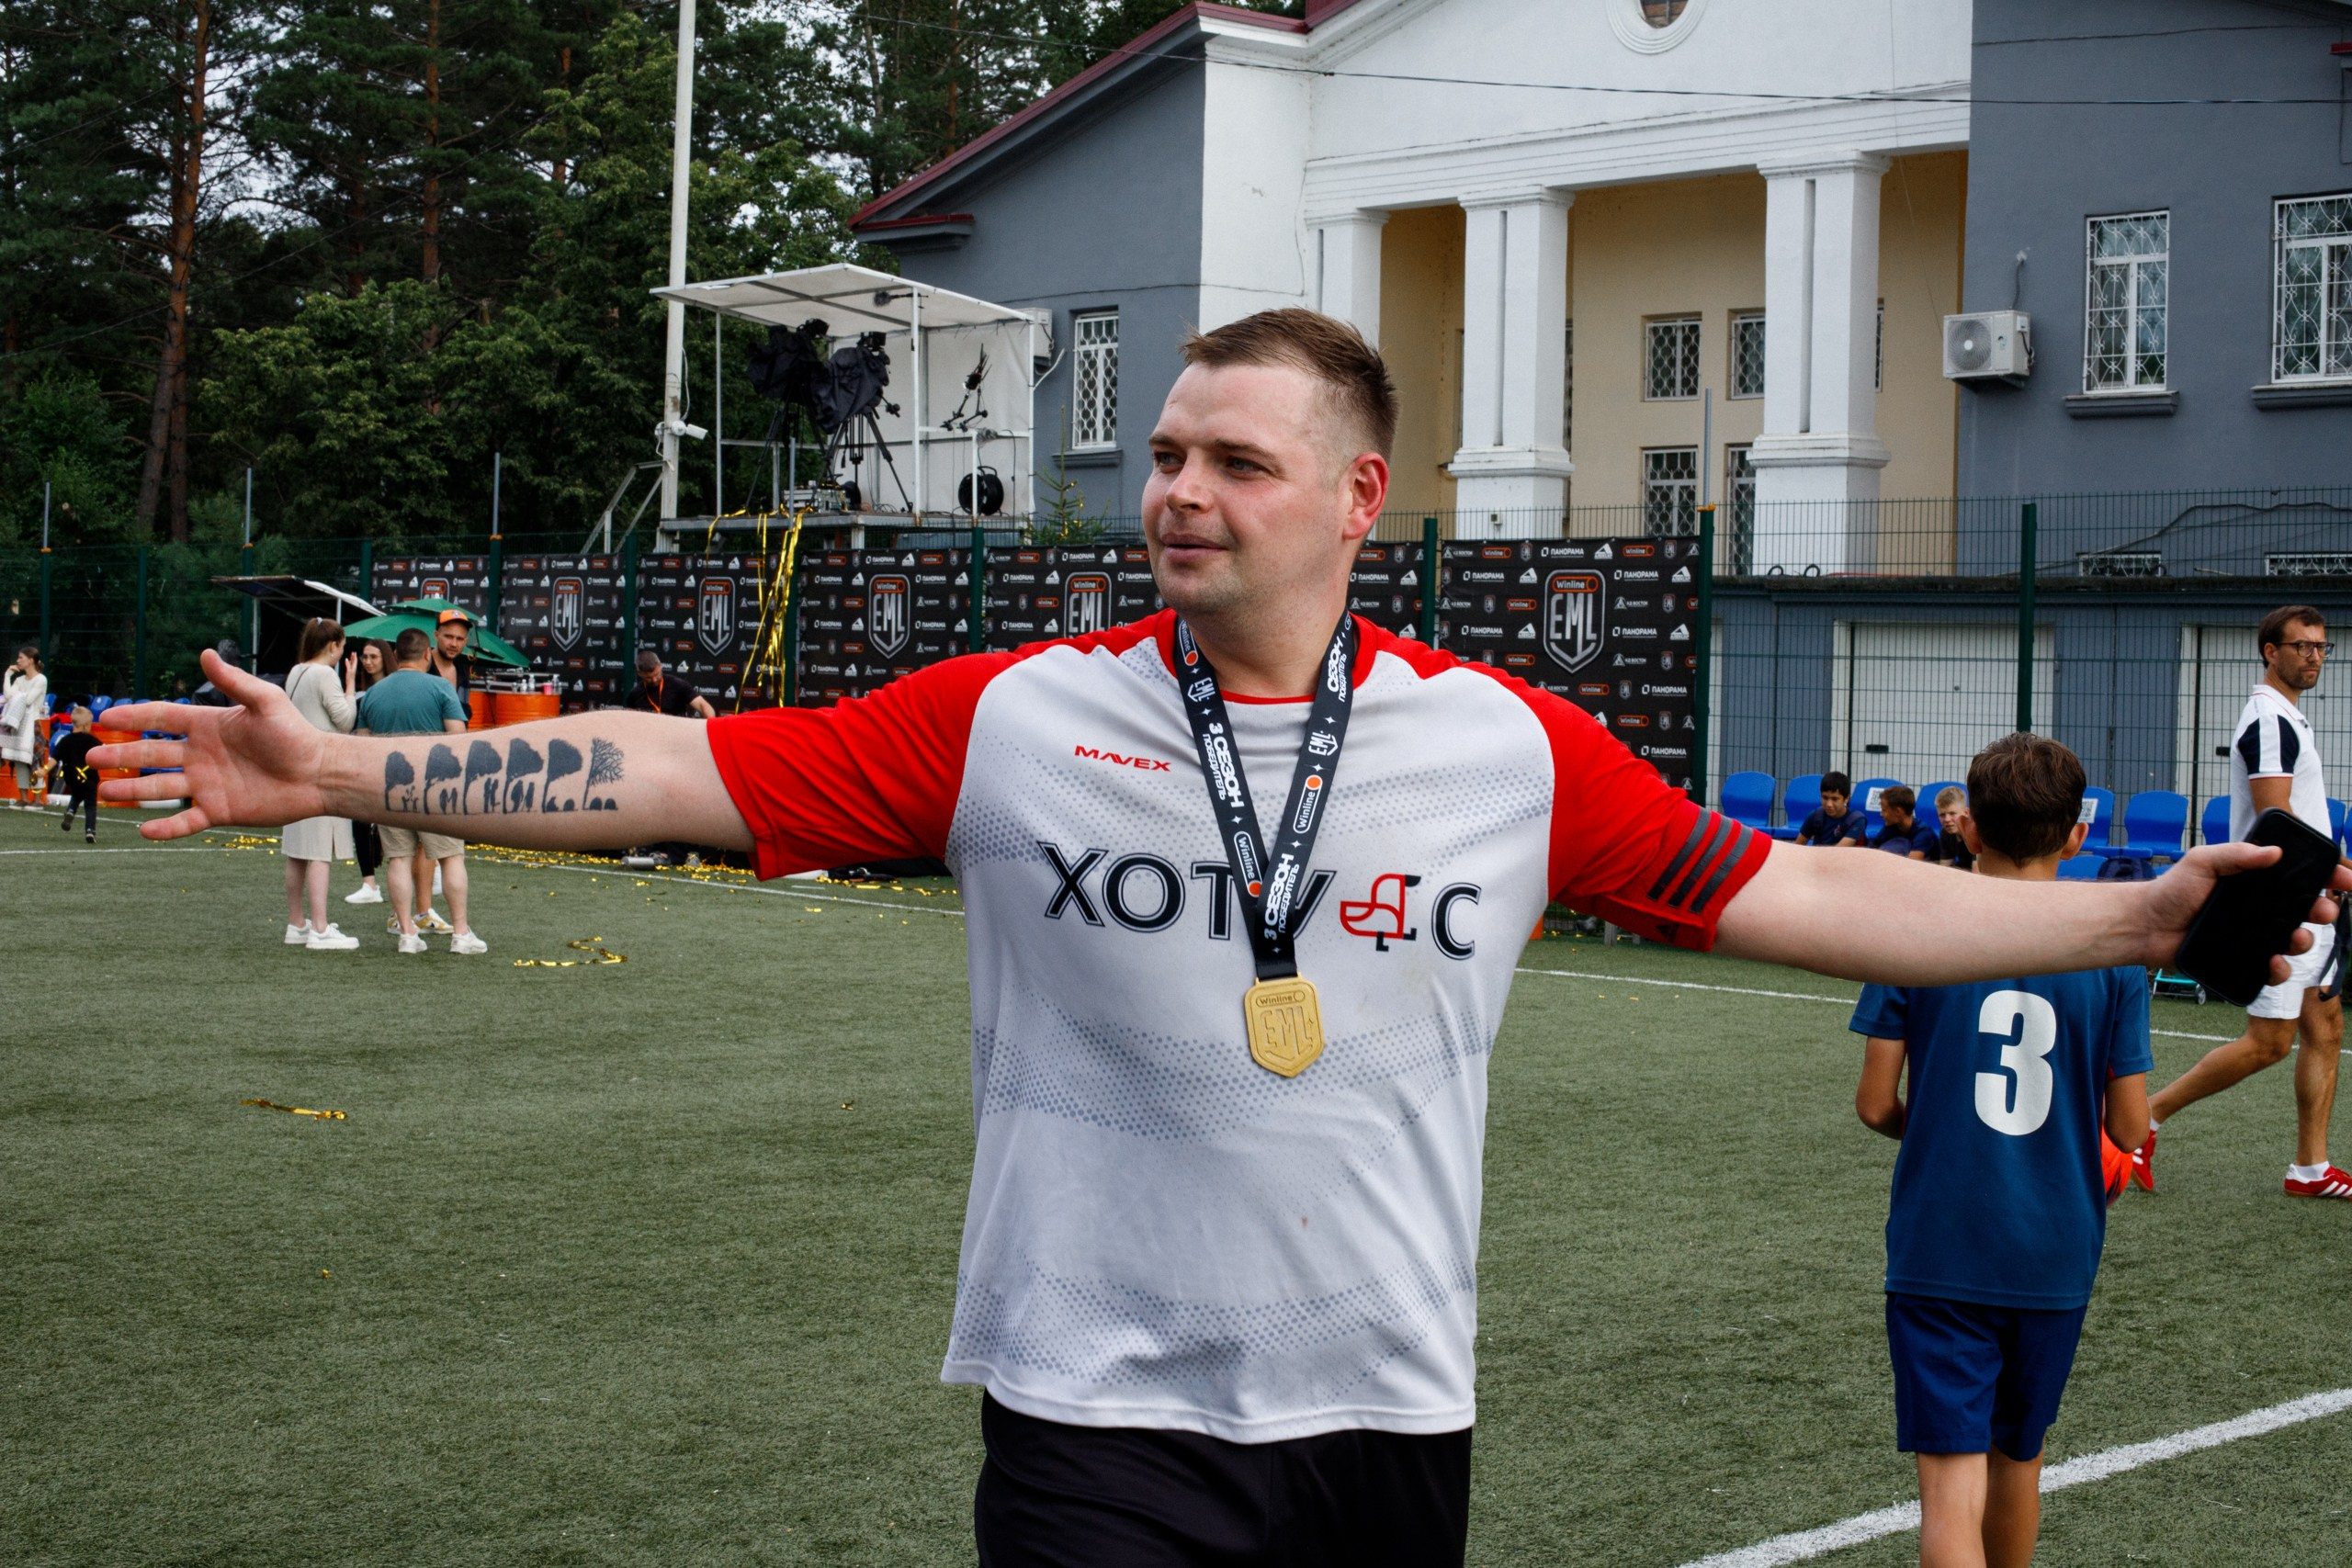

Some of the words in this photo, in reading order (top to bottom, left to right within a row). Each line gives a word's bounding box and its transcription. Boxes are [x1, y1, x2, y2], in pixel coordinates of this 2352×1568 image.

[1551, 547, 1584, 556] ПАНОРАМА
[1074, 581, 1096, 589] Winline
[1624, 570, 1659, 579] ПАНОРАМА
[555, 593, 579, 627] EML
[702, 595, 729, 631] EML
[874, 593, 906, 632] EML
[1069, 592, 1104, 633] EML
[1550, 593, 1597, 640] EML
[1327, 636, 1343, 693] СЕЗОН
[1338, 653, 1347, 703] ПОБЕДИТЕЛЬ
[1192, 676, 1216, 702] EML
[1652, 685, 1687, 694] ПАНОРАМА
[1209, 722, 1224, 735] 3
[1308, 730, 1333, 756] EML
[1074, 745, 1171, 773] MAVEX
[1202, 733, 1227, 801] ПОБЕДИТЕЛЬ
[1213, 736, 1245, 808] СЕЗОН
[1297, 790, 1316, 829] Winline
[1238, 837, 1256, 880] Winline
[1264, 852, 1295, 926] СЕЗОН
[1278, 863, 1300, 933] ПОБЕДИТЕЛЬ
[1264, 928, 1278, 941] 3
[1260, 994, 1294, 1005] Winline
[1260, 1005, 1314, 1053] EML
[1974, 989, 2057, 1136] 3
